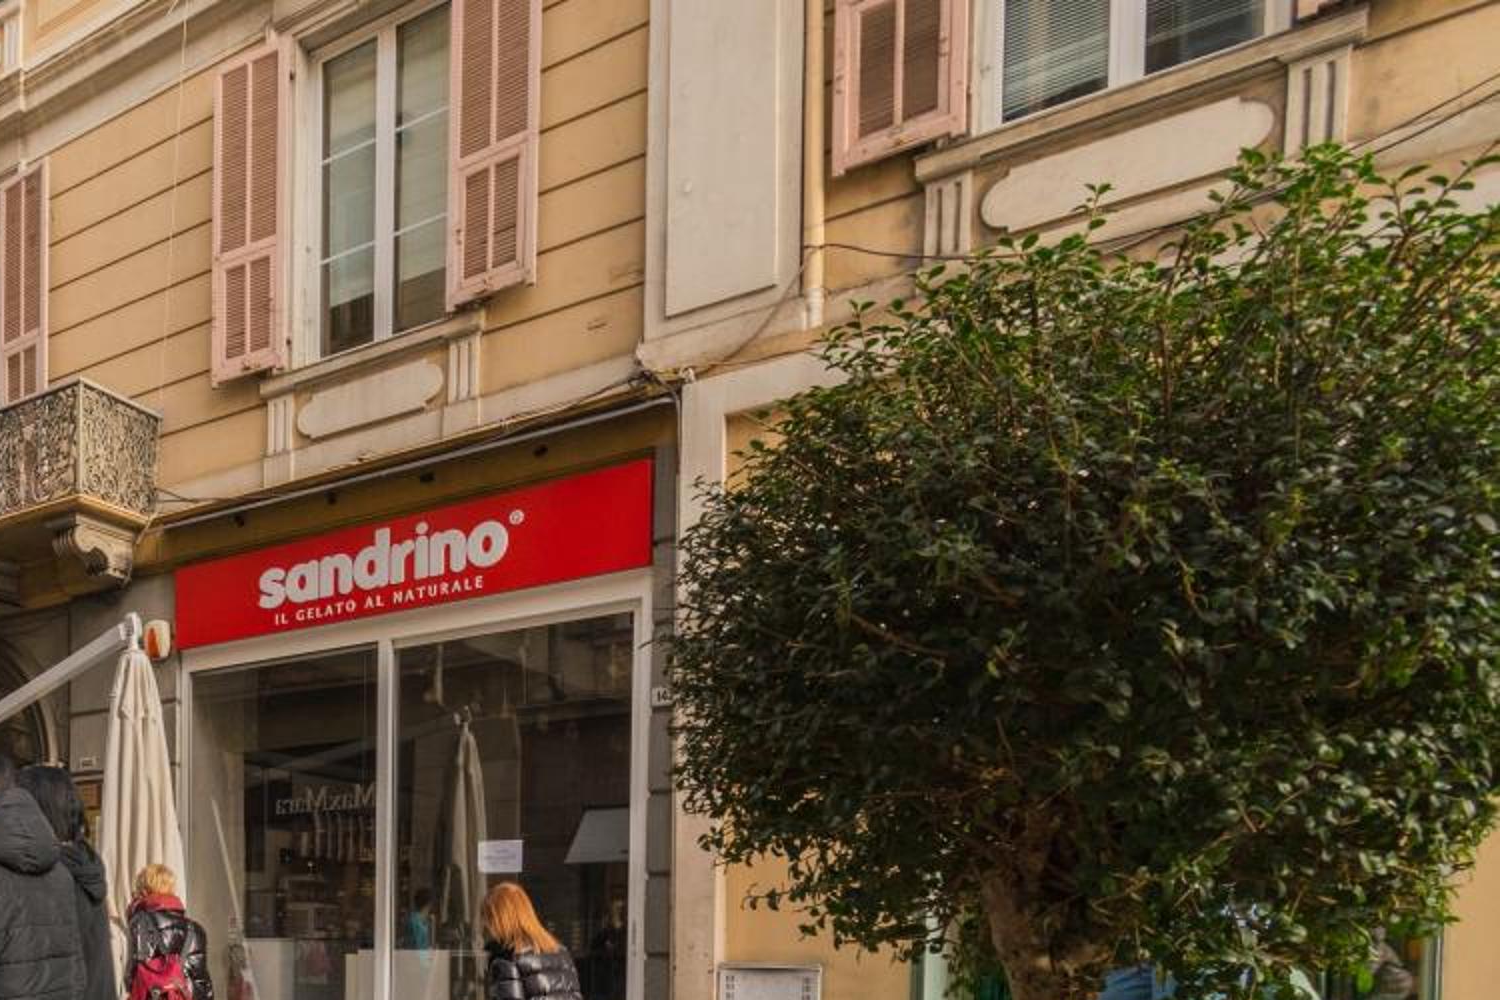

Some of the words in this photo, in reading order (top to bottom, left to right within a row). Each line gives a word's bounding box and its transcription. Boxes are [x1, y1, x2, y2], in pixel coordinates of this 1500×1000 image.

[258, 520, 509, 609] sandrino
[274, 612, 289, 626] IL
[295, 598, 357, 622] GELATO
[363, 595, 385, 609] AL
[392, 575, 484, 605] NATURALE
